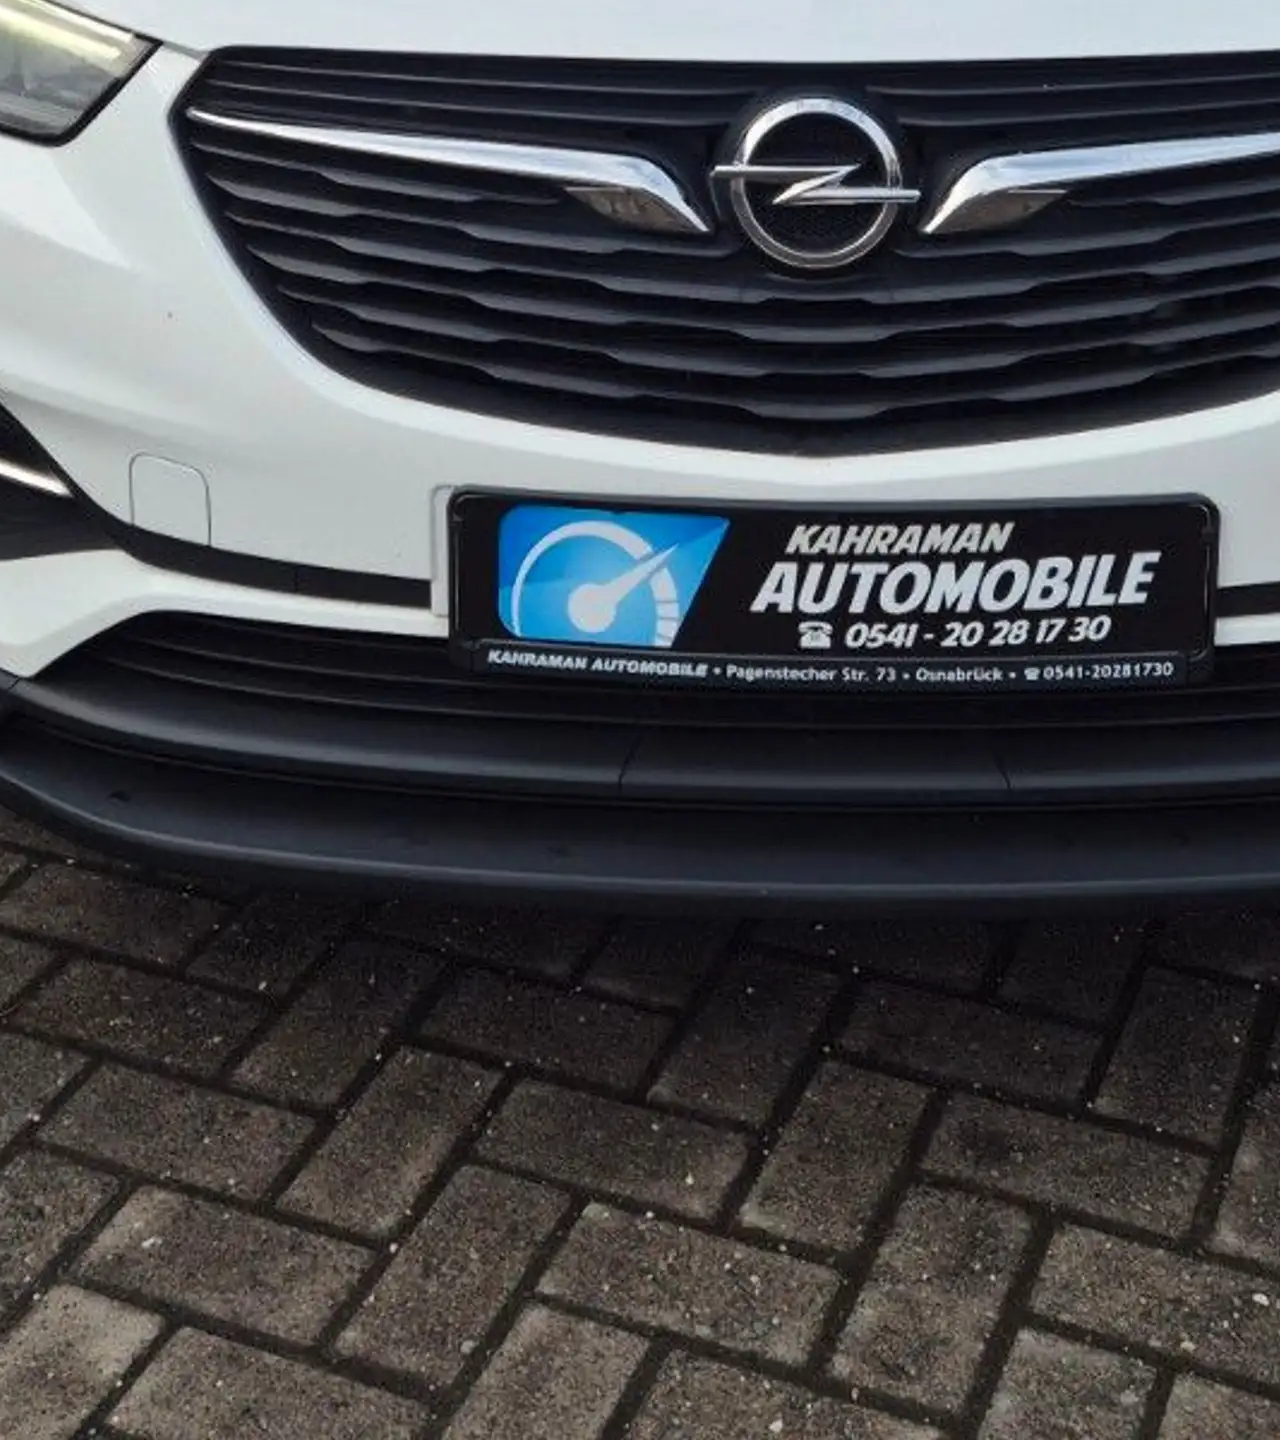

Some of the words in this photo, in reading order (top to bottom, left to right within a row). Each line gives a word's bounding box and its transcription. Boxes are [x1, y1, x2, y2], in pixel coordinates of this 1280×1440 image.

[785, 521, 1015, 556] KAHRAMAN
[750, 550, 1162, 615] AUTOMOBILE
[845, 621, 917, 649] 0541
[940, 620, 985, 648] 20
[988, 618, 1030, 647] 28
[1034, 617, 1067, 644] 17
[1068, 615, 1112, 642] 30
[487, 648, 587, 670] KAHRAMAN
[591, 658, 709, 678] AUTOMOBILE
[726, 663, 834, 682] Pagenstecher
[841, 666, 869, 682] Str.
[876, 667, 897, 682] 73
[915, 664, 1004, 682] Osnabrück
[1043, 661, 1175, 681] 0541-20281730
